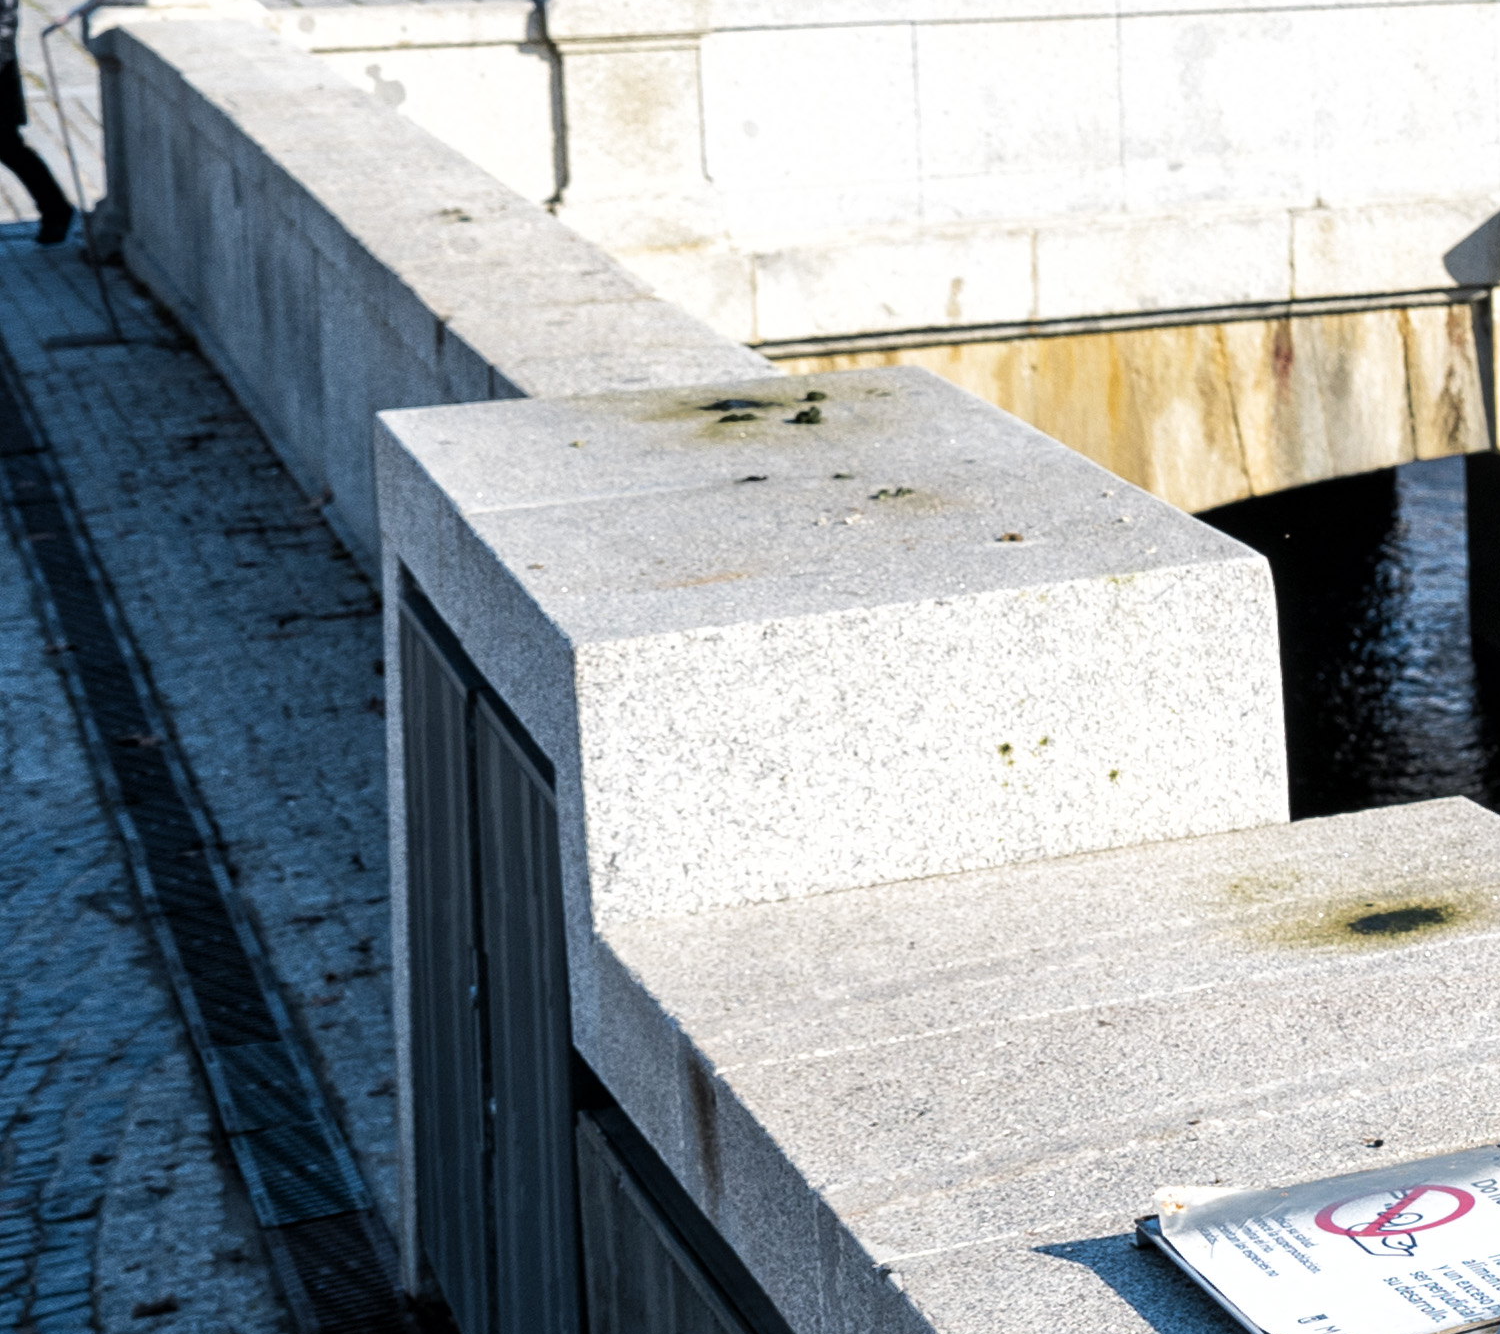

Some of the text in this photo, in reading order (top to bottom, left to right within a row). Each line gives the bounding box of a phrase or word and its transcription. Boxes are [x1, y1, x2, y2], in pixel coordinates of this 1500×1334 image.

[1470, 1178, 1499, 1194] Do
[1382, 1276, 1449, 1323] su desarrollo.
[1409, 1270, 1486, 1319] ser perjudicial
[1442, 1269, 1464, 1282] un
[1455, 1279, 1495, 1306] exceso
